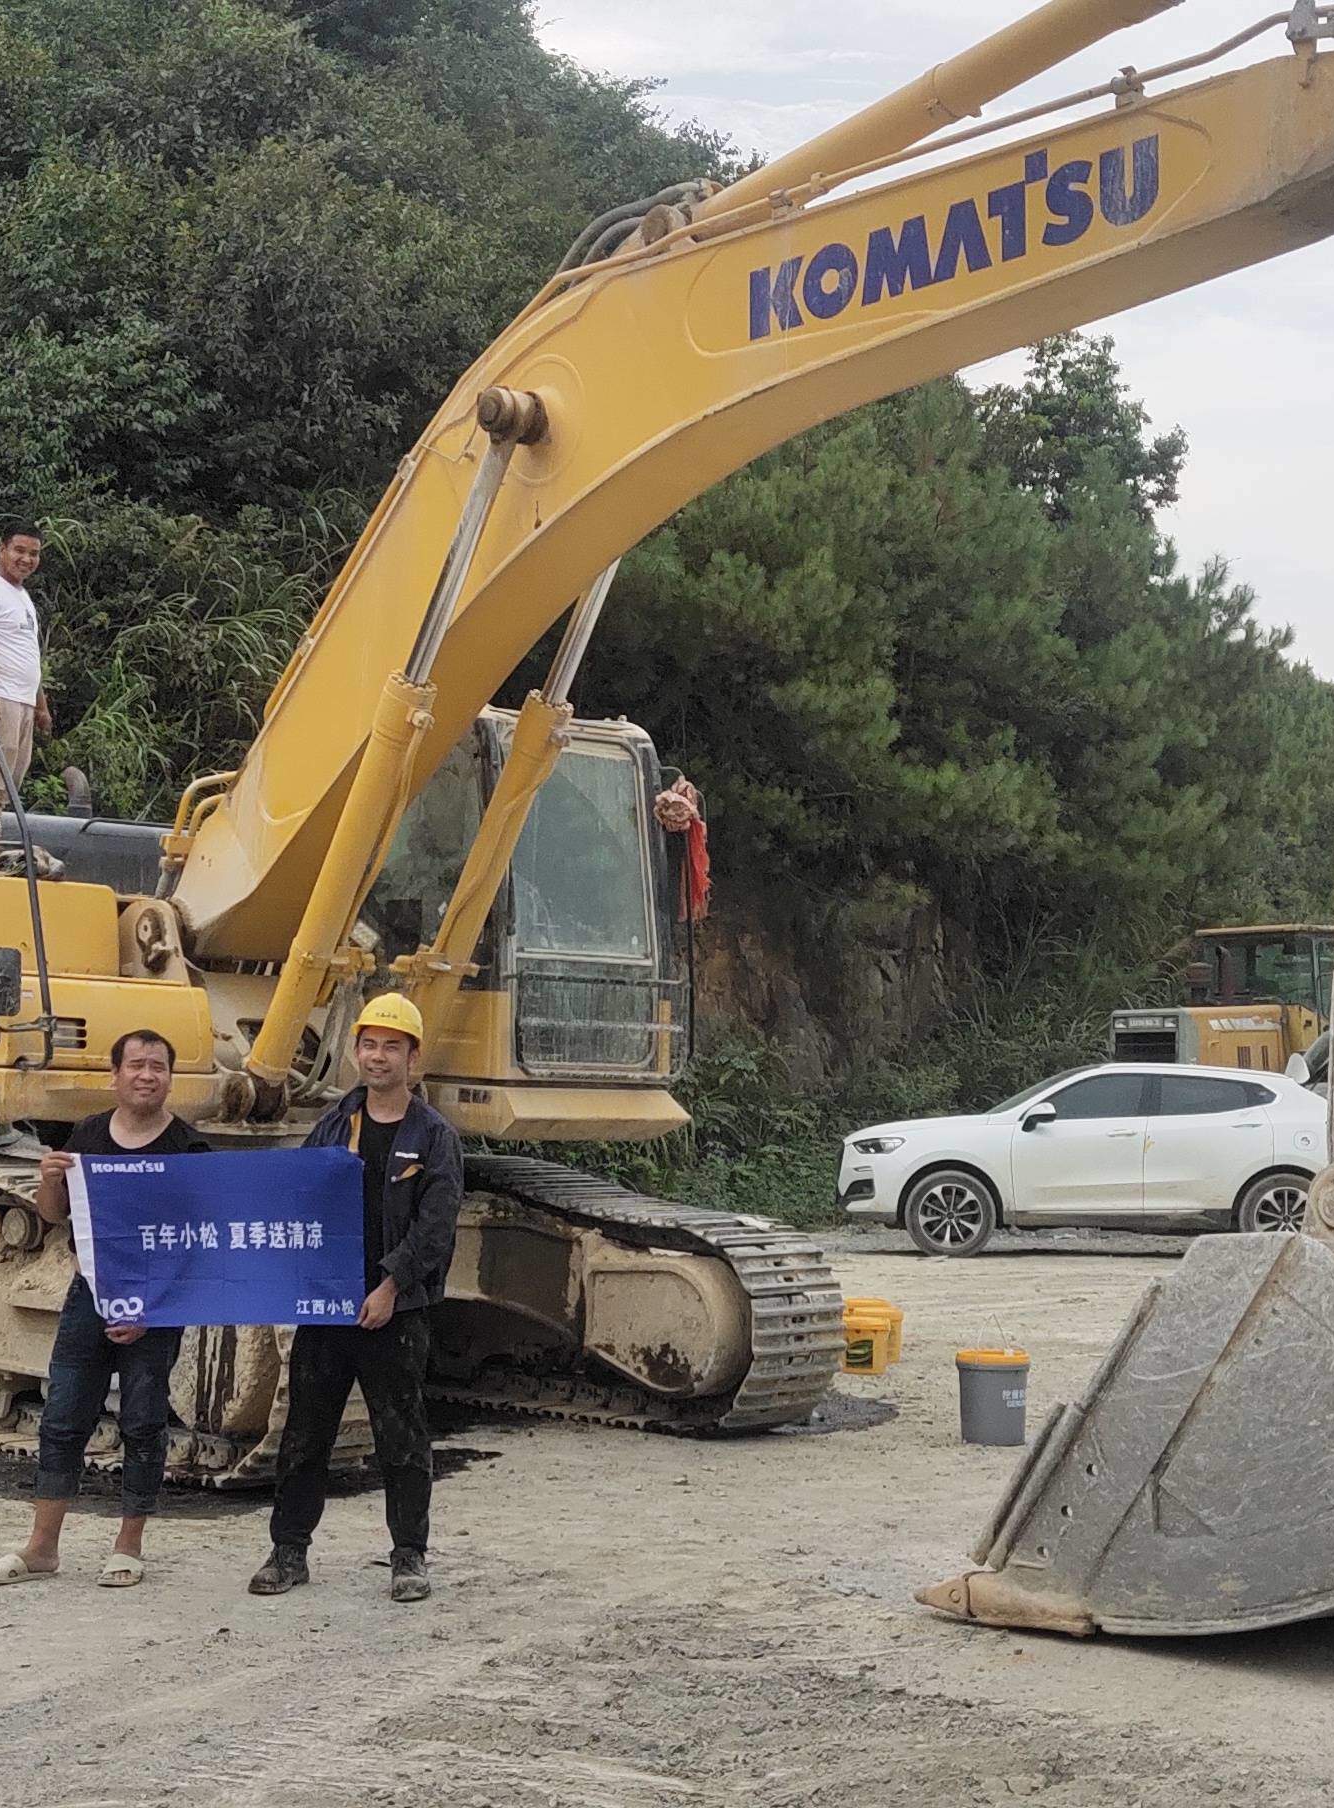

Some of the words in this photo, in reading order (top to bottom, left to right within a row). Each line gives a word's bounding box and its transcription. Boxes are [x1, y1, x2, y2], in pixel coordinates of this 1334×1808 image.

[749, 133, 1160, 341] KOMATSU
[90, 1159, 165, 1174] KOMATSU
[137, 1221, 219, 1251] 百年小松
[228, 1220, 324, 1250] 夏季送清凉
[296, 1299, 355, 1316] 江西小松
